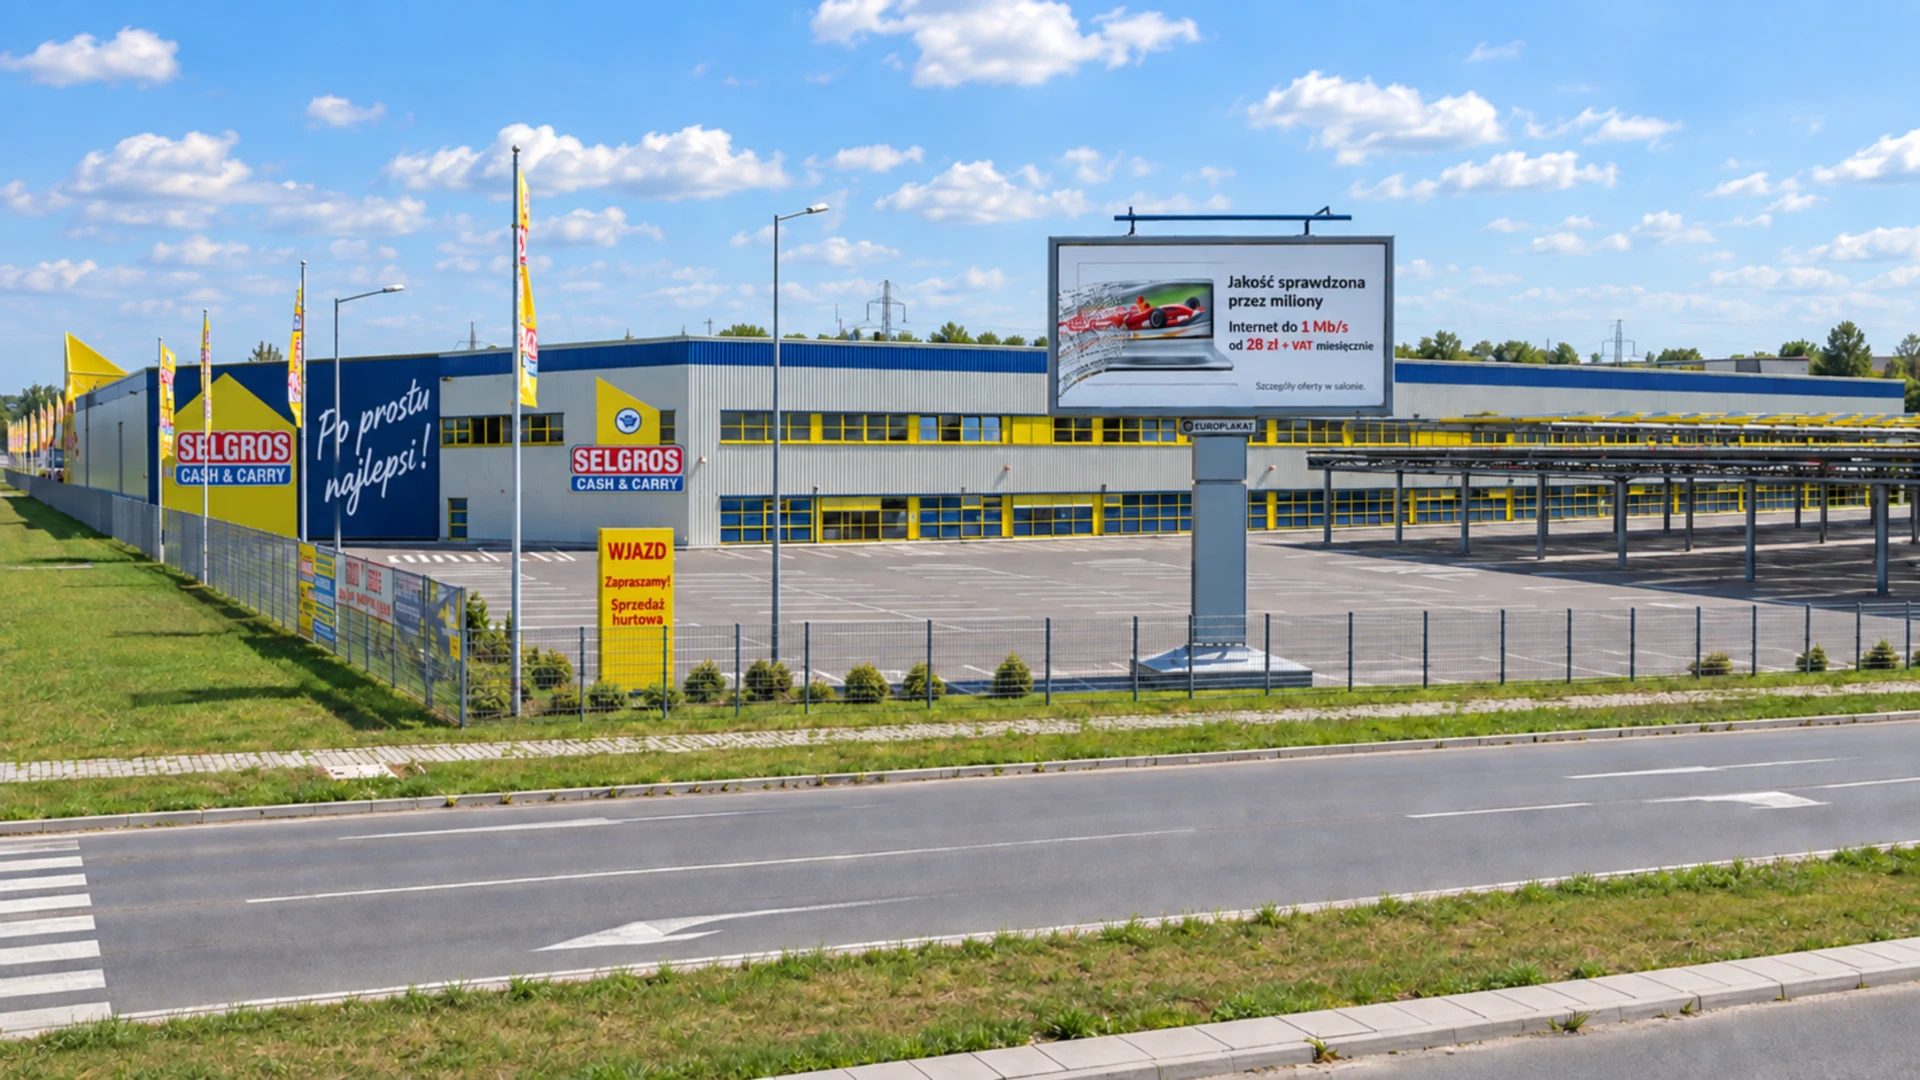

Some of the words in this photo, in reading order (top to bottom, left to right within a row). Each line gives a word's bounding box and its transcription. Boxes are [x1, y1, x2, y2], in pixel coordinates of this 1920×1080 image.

[1228, 275, 1274, 289] Jakość
[1278, 275, 1366, 291] sprawdzona
[1229, 297, 1266, 309] przez
[1271, 294, 1323, 310] miliony
[1229, 321, 1278, 333] Internet
[1282, 321, 1298, 333] do
[1301, 321, 1310, 333] 1
[1313, 320, 1349, 334] Mb/s
[1229, 340, 1243, 351] od
[1246, 338, 1264, 351] 28
[1267, 338, 1279, 351] zł
[1292, 341, 1313, 351] VAT
[1316, 341, 1374, 353] miesięcznie
[1297, 381, 1323, 392] oferty
[1324, 383, 1332, 391] w
[1334, 382, 1367, 391] salonie.
[317, 408, 349, 461] Po
[355, 378, 430, 456] prostu
[1195, 422, 1253, 430] EUROPLAKAT
[179, 434, 289, 461] SELGROS
[574, 449, 679, 472] SELGROS
[222, 468, 233, 483] &
[237, 468, 286, 483] CARRY
[324, 422, 431, 516] najlepsi!
[576, 478, 614, 490] CASH
[618, 478, 628, 490] &
[631, 478, 678, 490] CARRY
[607, 542, 667, 560] WJAZD
[605, 575, 671, 590] Zapraszamy!
[611, 597, 665, 614] Sprzedaż
[612, 614, 664, 626] hurtowa
